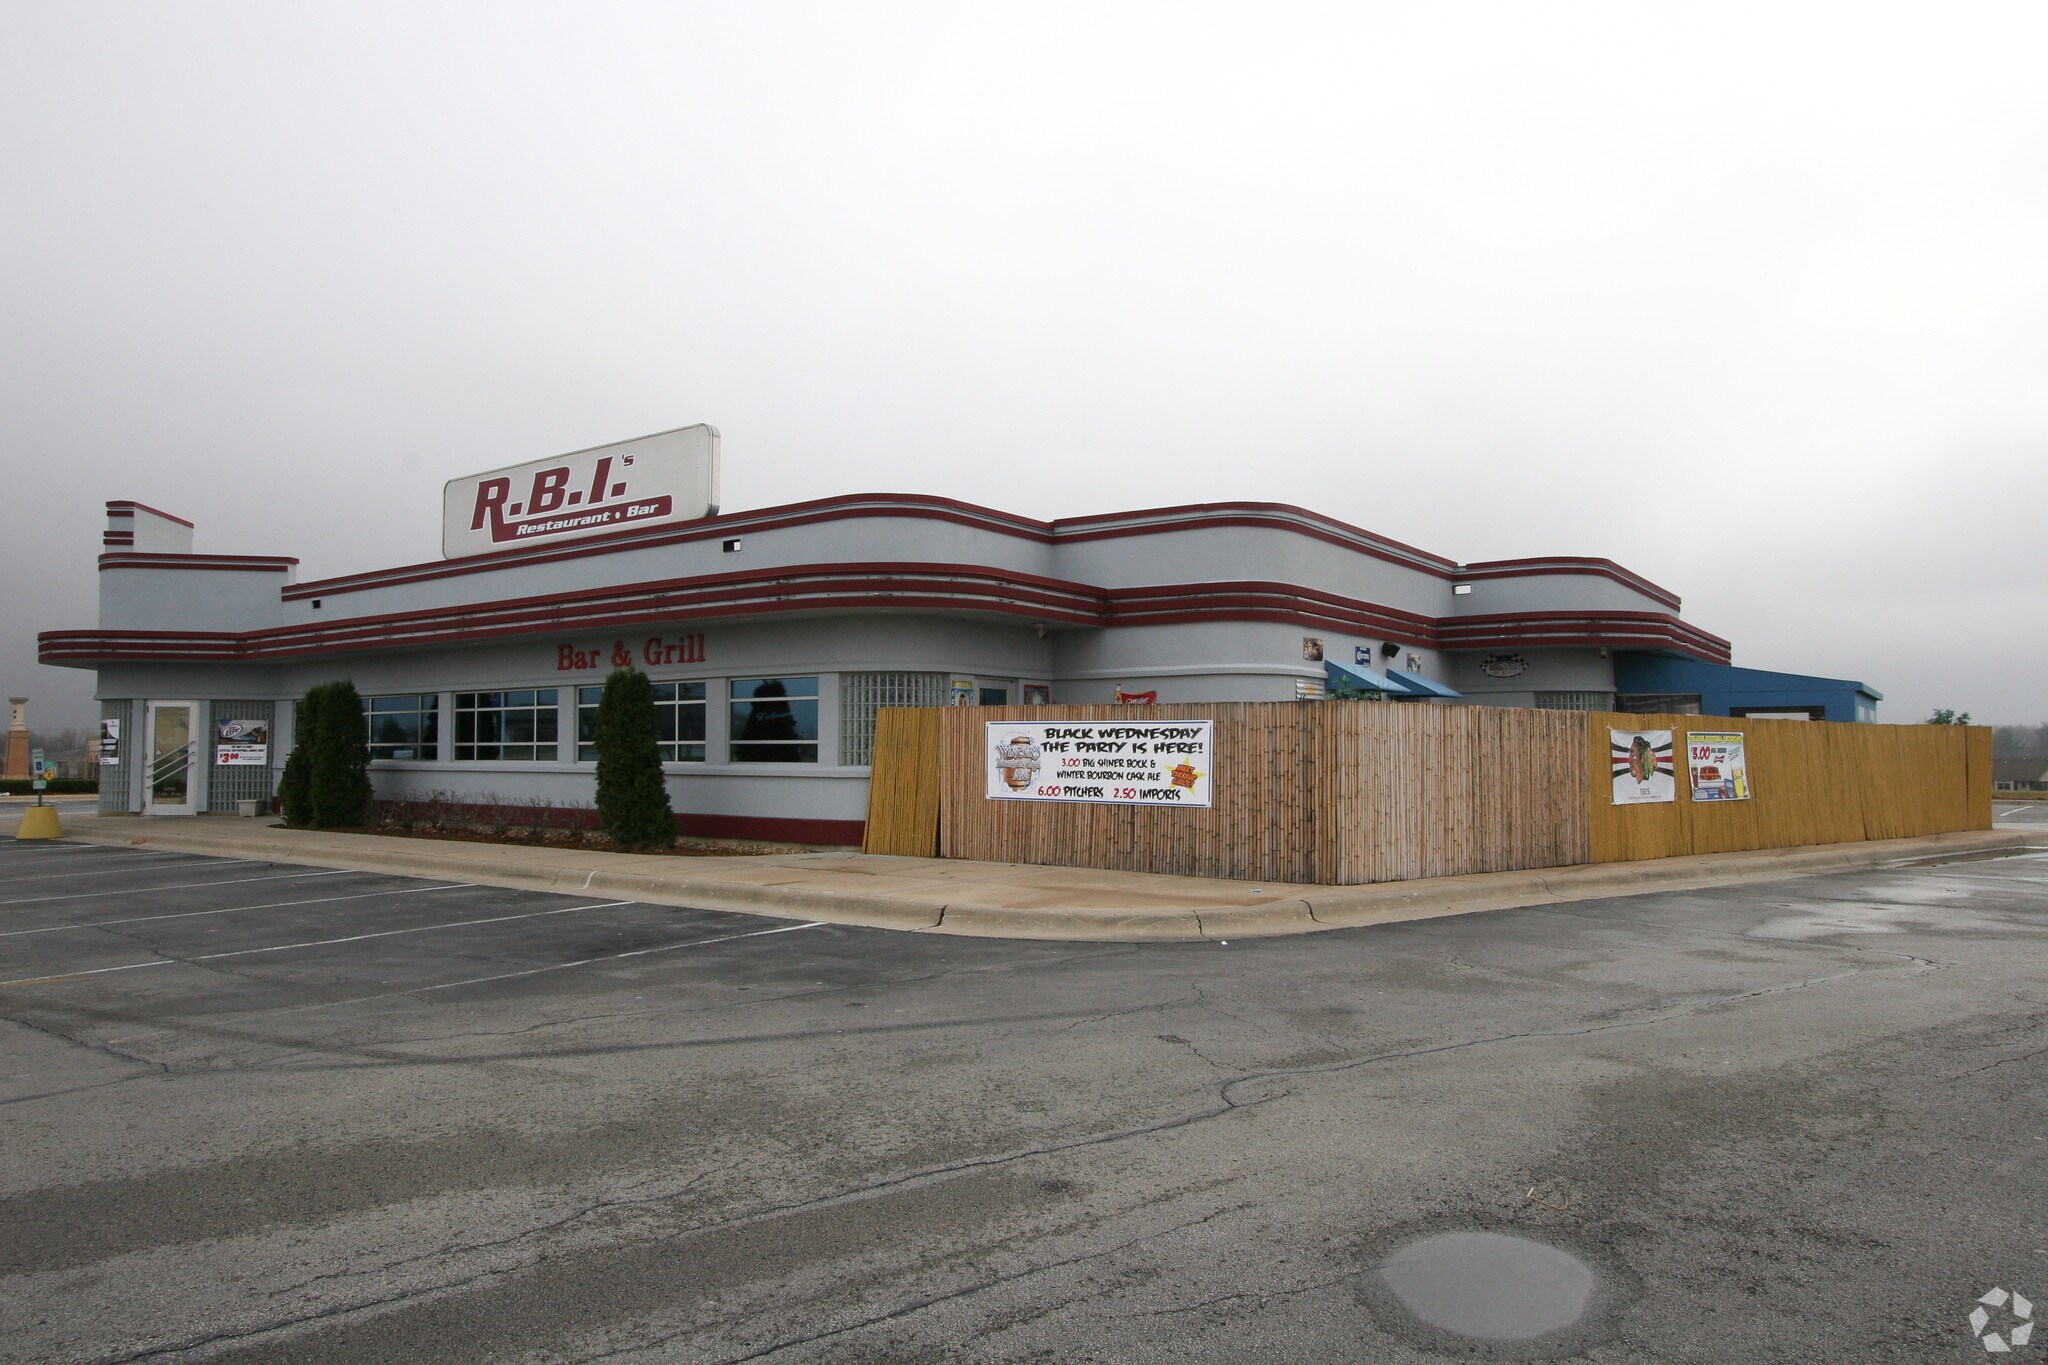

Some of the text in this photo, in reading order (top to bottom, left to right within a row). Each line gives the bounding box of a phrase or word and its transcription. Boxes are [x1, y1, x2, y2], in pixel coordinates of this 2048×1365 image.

[470, 455, 634, 532] R.B.I.'s
[516, 501, 659, 536] Restaurant Bar
[557, 633, 705, 670] Bar & Grill
[1044, 727, 1203, 740] BLACK WEDNESDAY
[1041, 741, 1204, 754] THE PARTY IS HERE!
[1061, 758, 1156, 768] 3.00 BIG SHINER BOCK &
[1056, 771, 1161, 781] WINTER BOURBON CASK ALE
[1037, 786, 1104, 798] 6.00 PITCHERS
[1113, 788, 1181, 800] 2.50 IMPORTS
